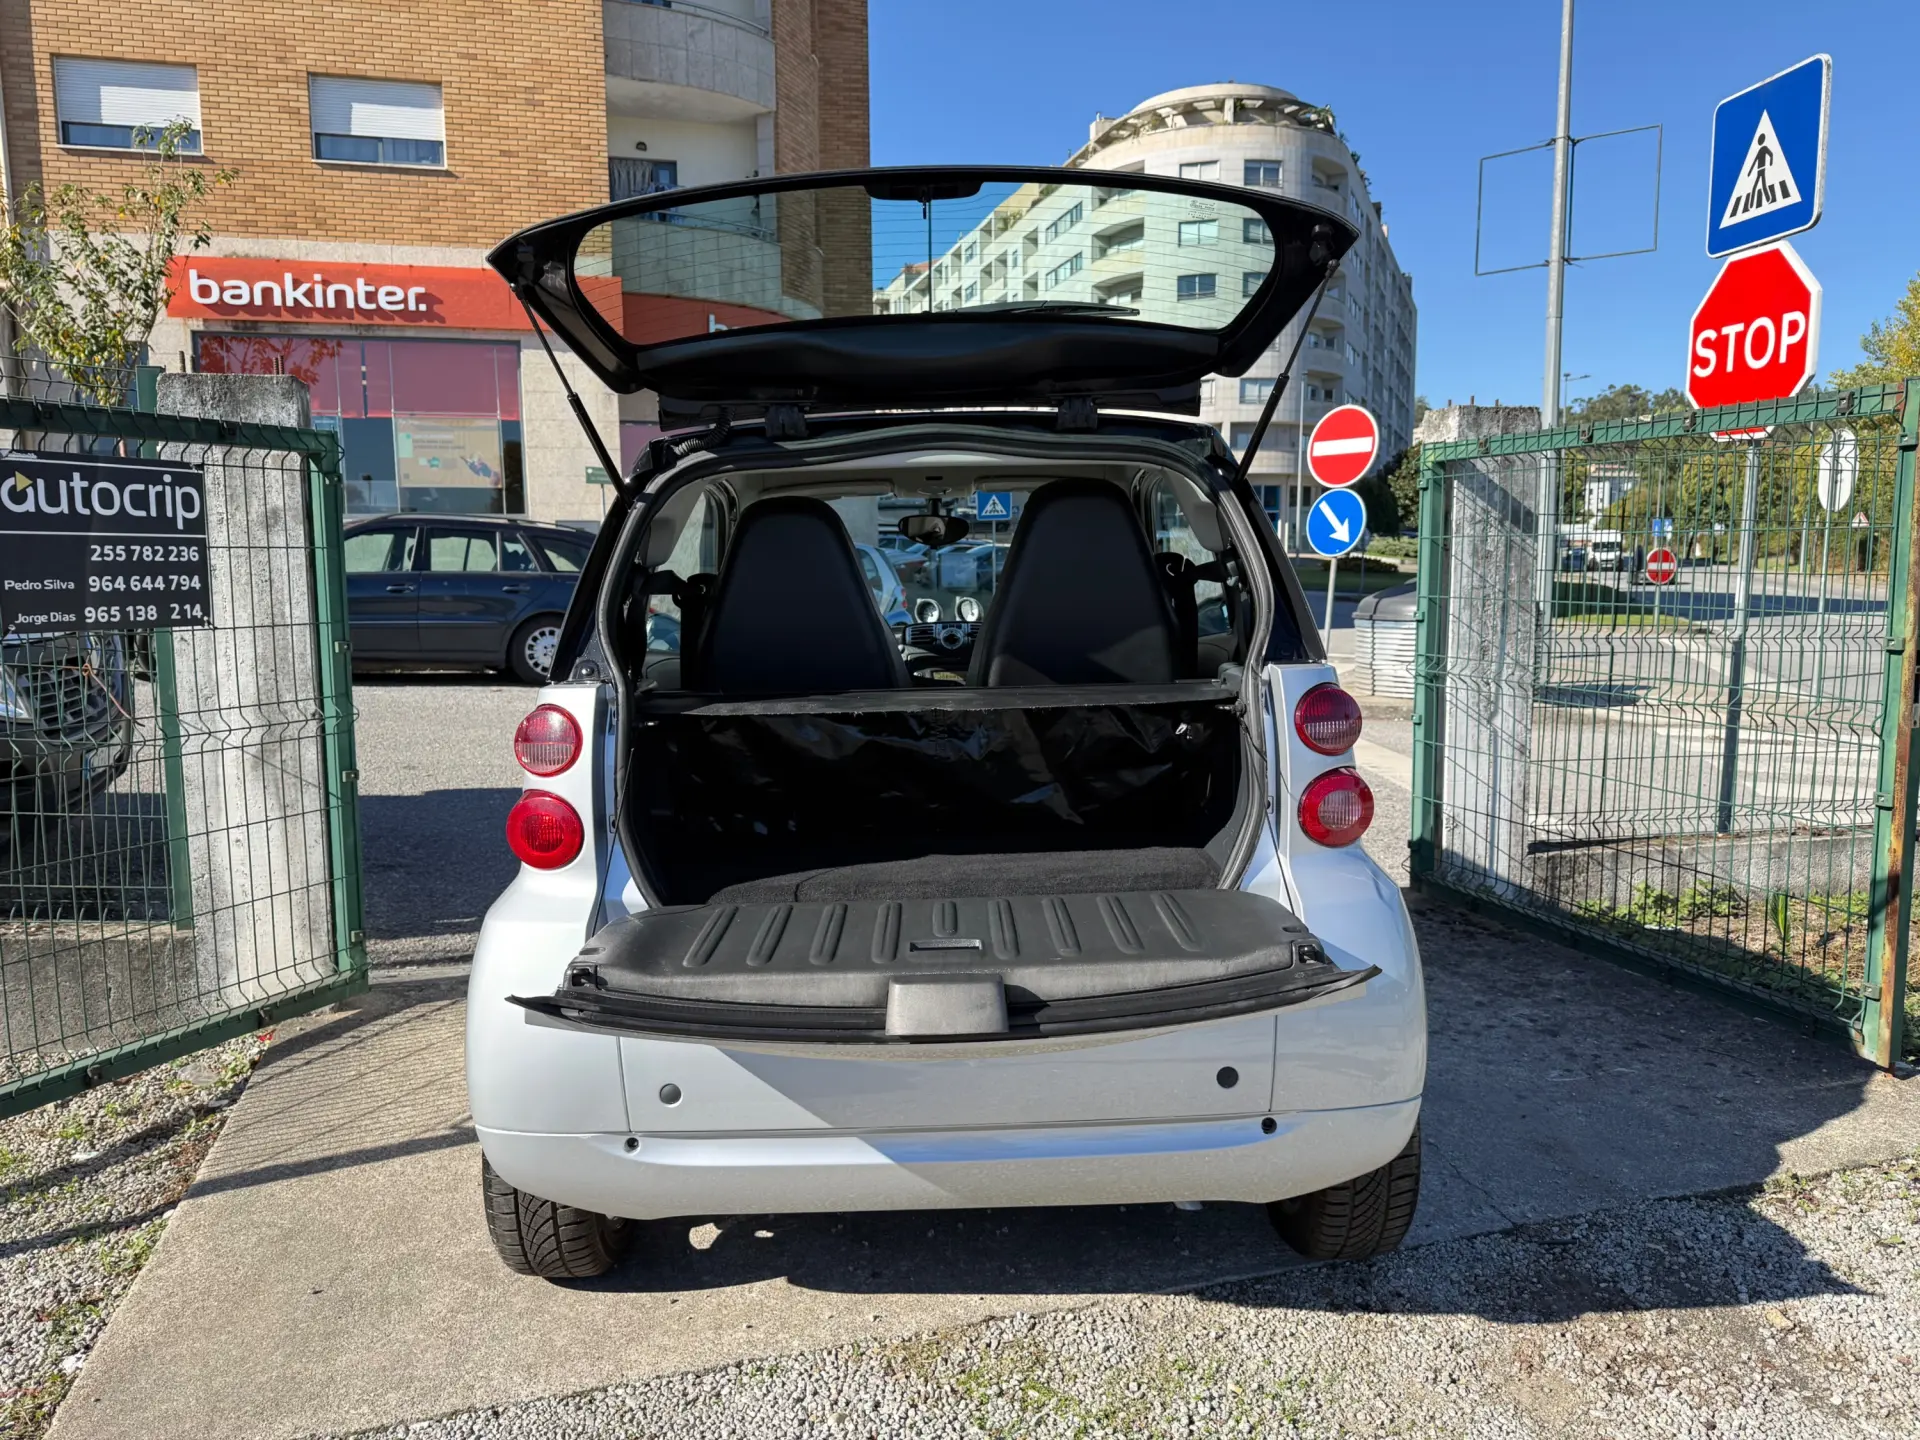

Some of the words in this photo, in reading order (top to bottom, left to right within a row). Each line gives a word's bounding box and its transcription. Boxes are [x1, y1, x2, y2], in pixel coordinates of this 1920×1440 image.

[188, 268, 428, 312] bankinter.
[1693, 310, 1806, 378] STOP
[0, 470, 201, 530] autocrip
[90, 545, 126, 561] 255
[130, 546, 165, 561] 782
[168, 546, 199, 561] 236
[4, 579, 42, 591] Pedro
[43, 579, 75, 590] Silva
[88, 576, 126, 592] 964
[130, 576, 166, 591] 644
[169, 575, 201, 591] 794
[14, 613, 49, 625] Jorge
[50, 612, 76, 623] Dias
[84, 606, 121, 623] 965
[126, 605, 158, 621] 138
